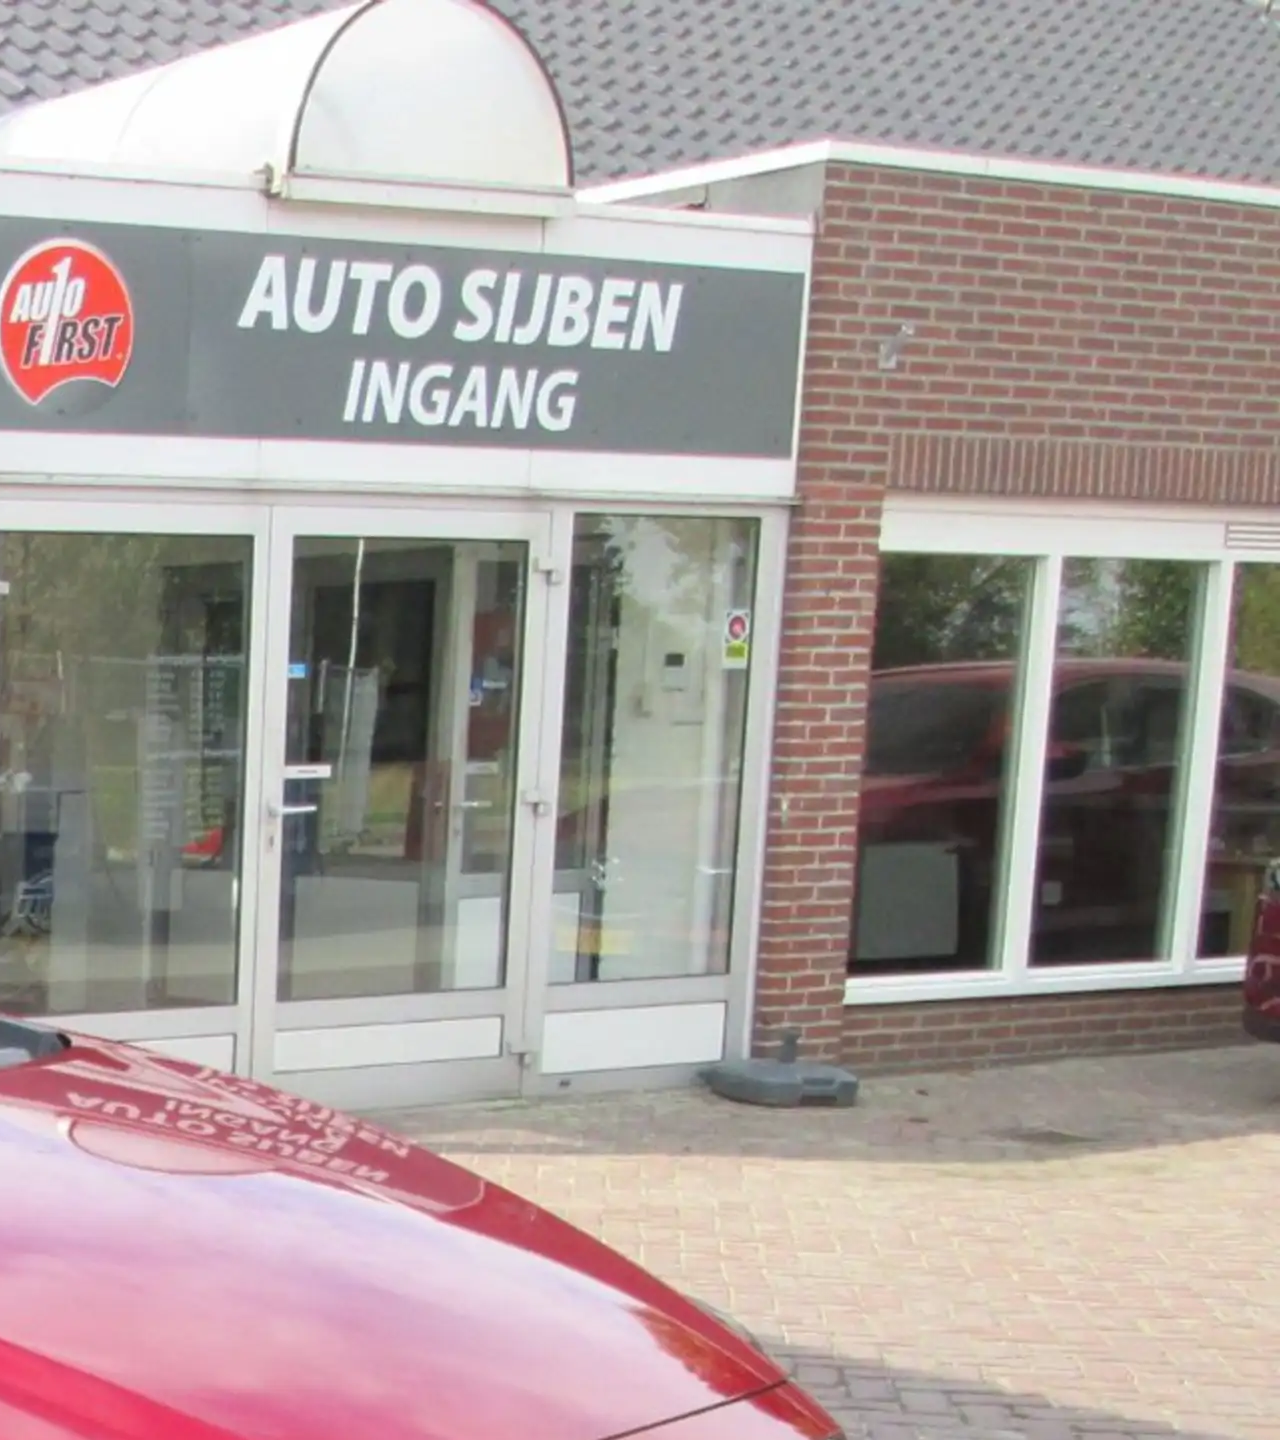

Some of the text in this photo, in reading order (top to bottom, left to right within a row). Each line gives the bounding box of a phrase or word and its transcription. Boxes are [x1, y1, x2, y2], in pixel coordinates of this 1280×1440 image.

[237, 254, 683, 352] AUTO SIJBEN
[343, 359, 579, 431] INGANG
